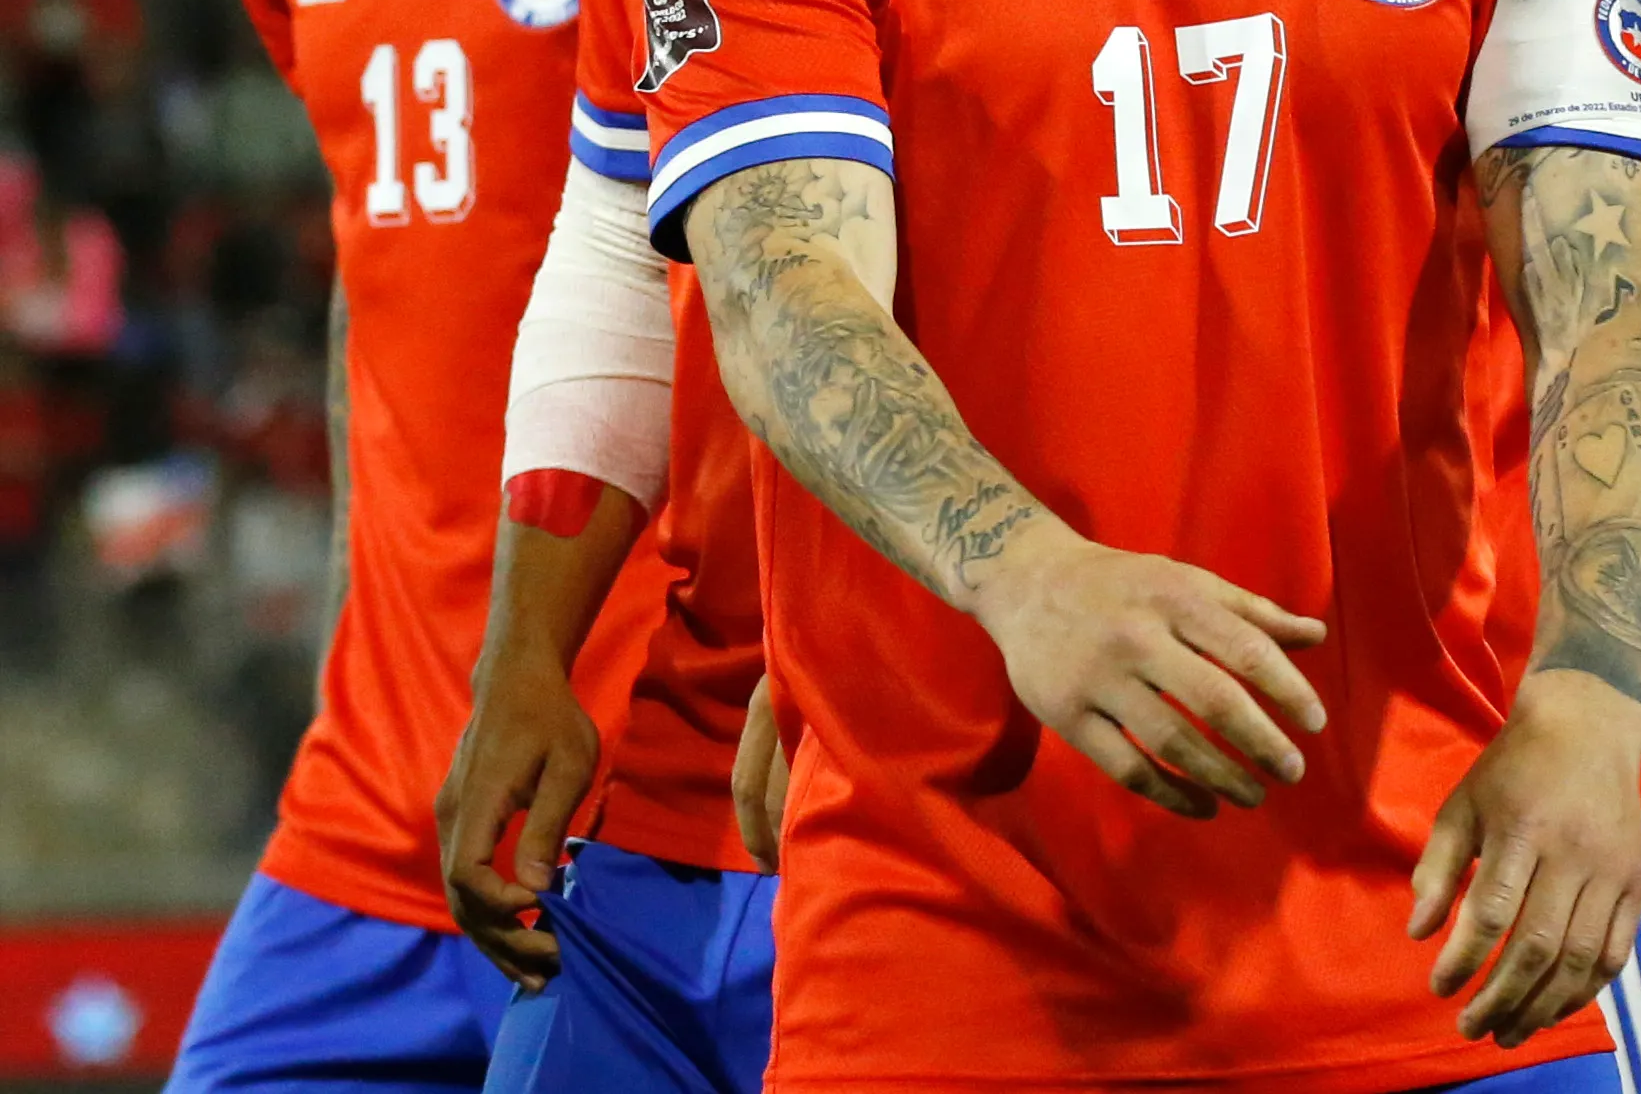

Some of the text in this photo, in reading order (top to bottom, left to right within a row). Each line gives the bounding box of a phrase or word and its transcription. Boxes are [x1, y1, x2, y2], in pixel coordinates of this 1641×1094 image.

[360, 38, 477, 228] 13
[1092, 12, 1287, 246] 17
[1508, 115, 1521, 127] 29
[1521, 112, 1534, 123] de
[1535, 106, 1567, 119] marzo
[1567, 102, 1582, 113] de
